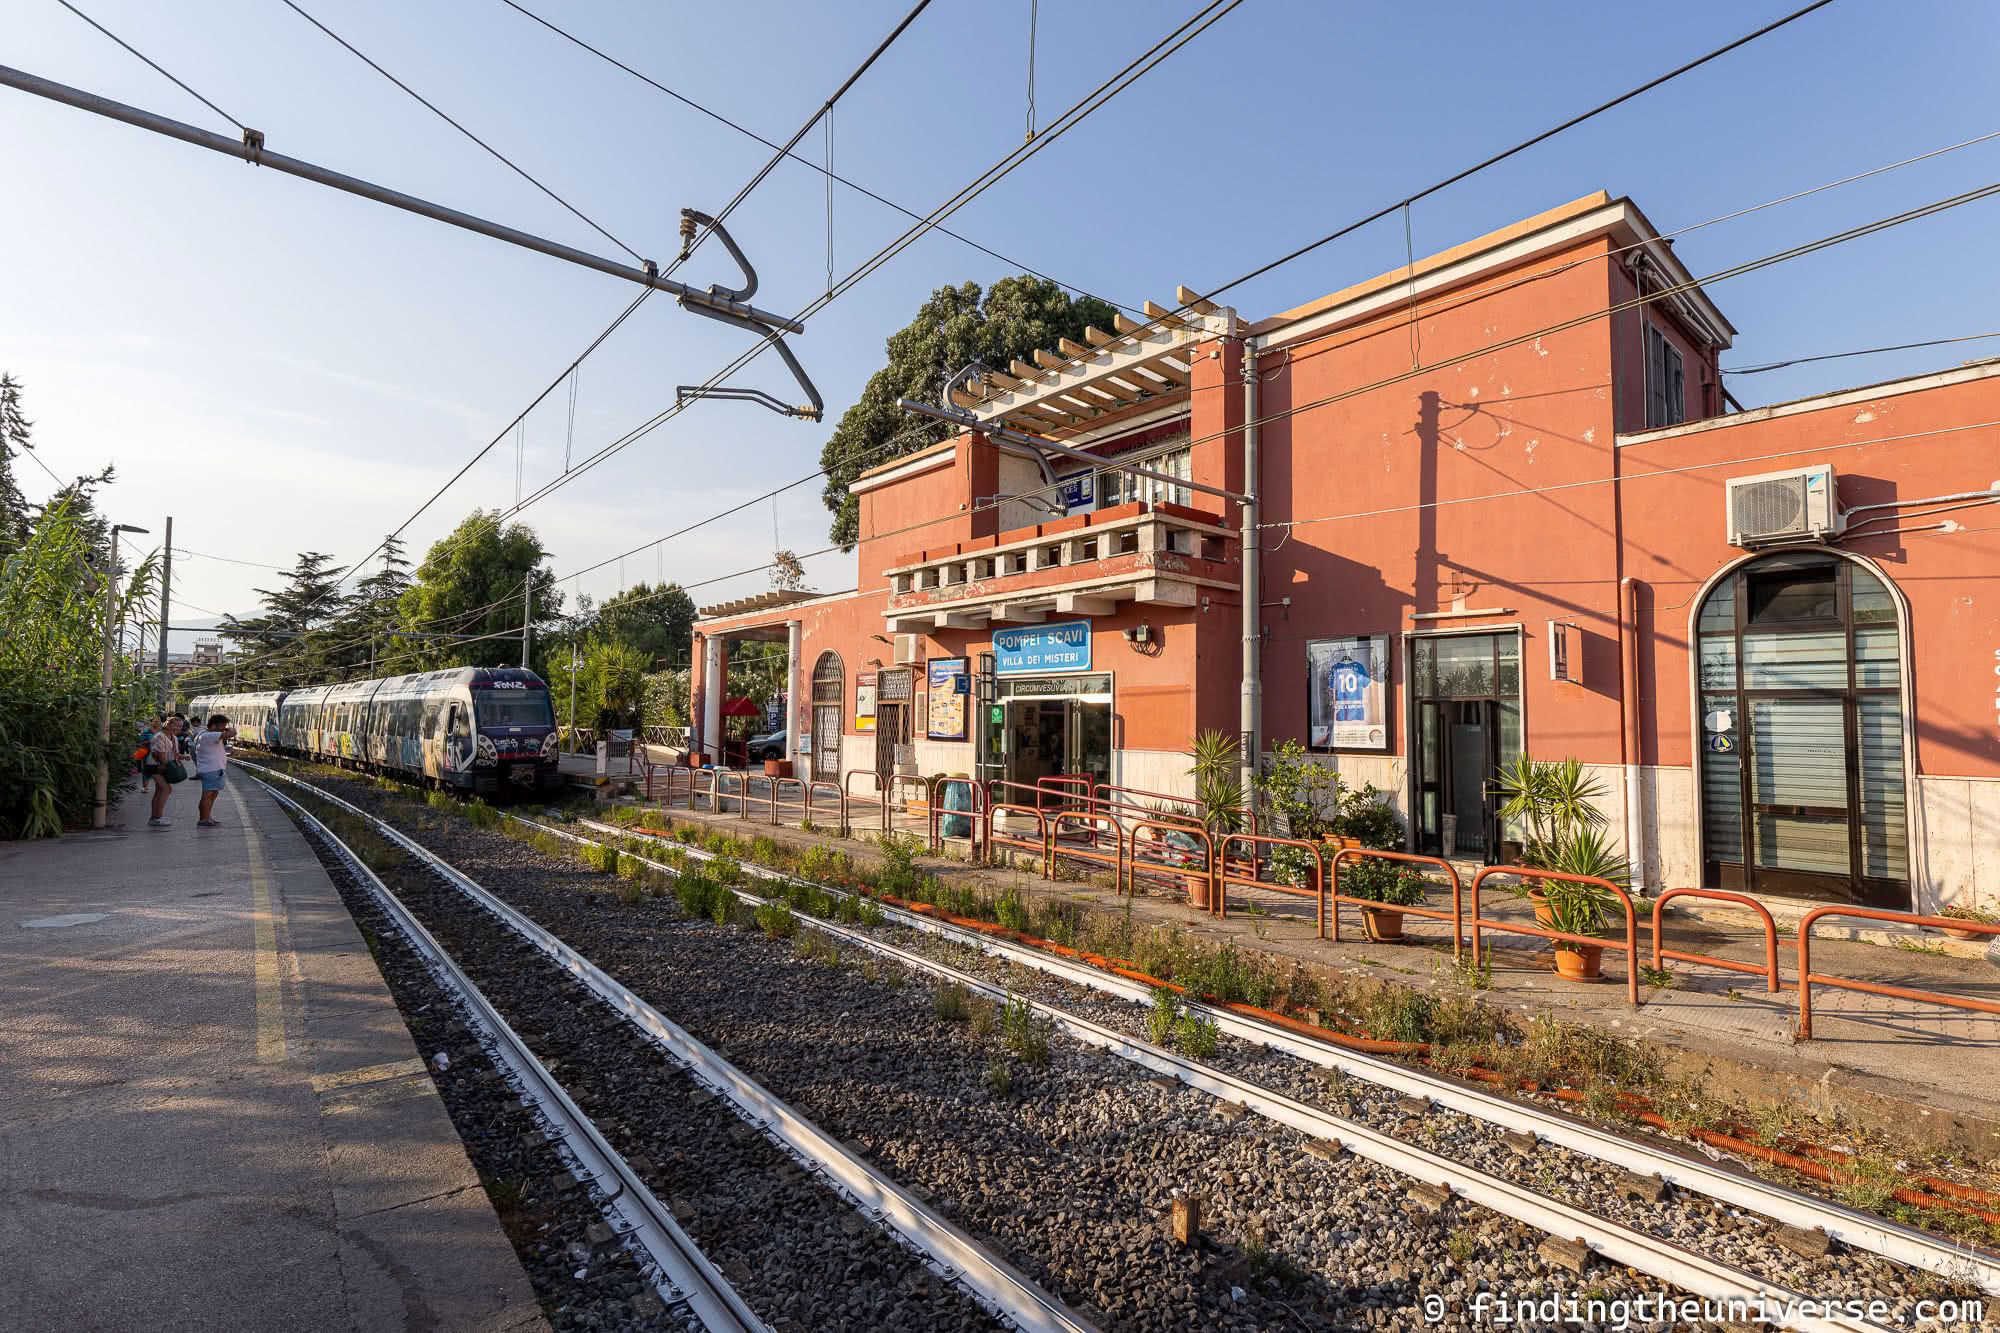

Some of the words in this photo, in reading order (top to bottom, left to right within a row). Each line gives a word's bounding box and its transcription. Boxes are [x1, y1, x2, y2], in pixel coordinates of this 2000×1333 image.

[999, 633, 1040, 649] POMPEI
[1047, 629, 1083, 645] SCAVI
[1002, 656, 1023, 667] VILLA
[1027, 655, 1040, 665] DEI
[1044, 652, 1079, 664] MISTERI
[1338, 673, 1358, 693] 10
